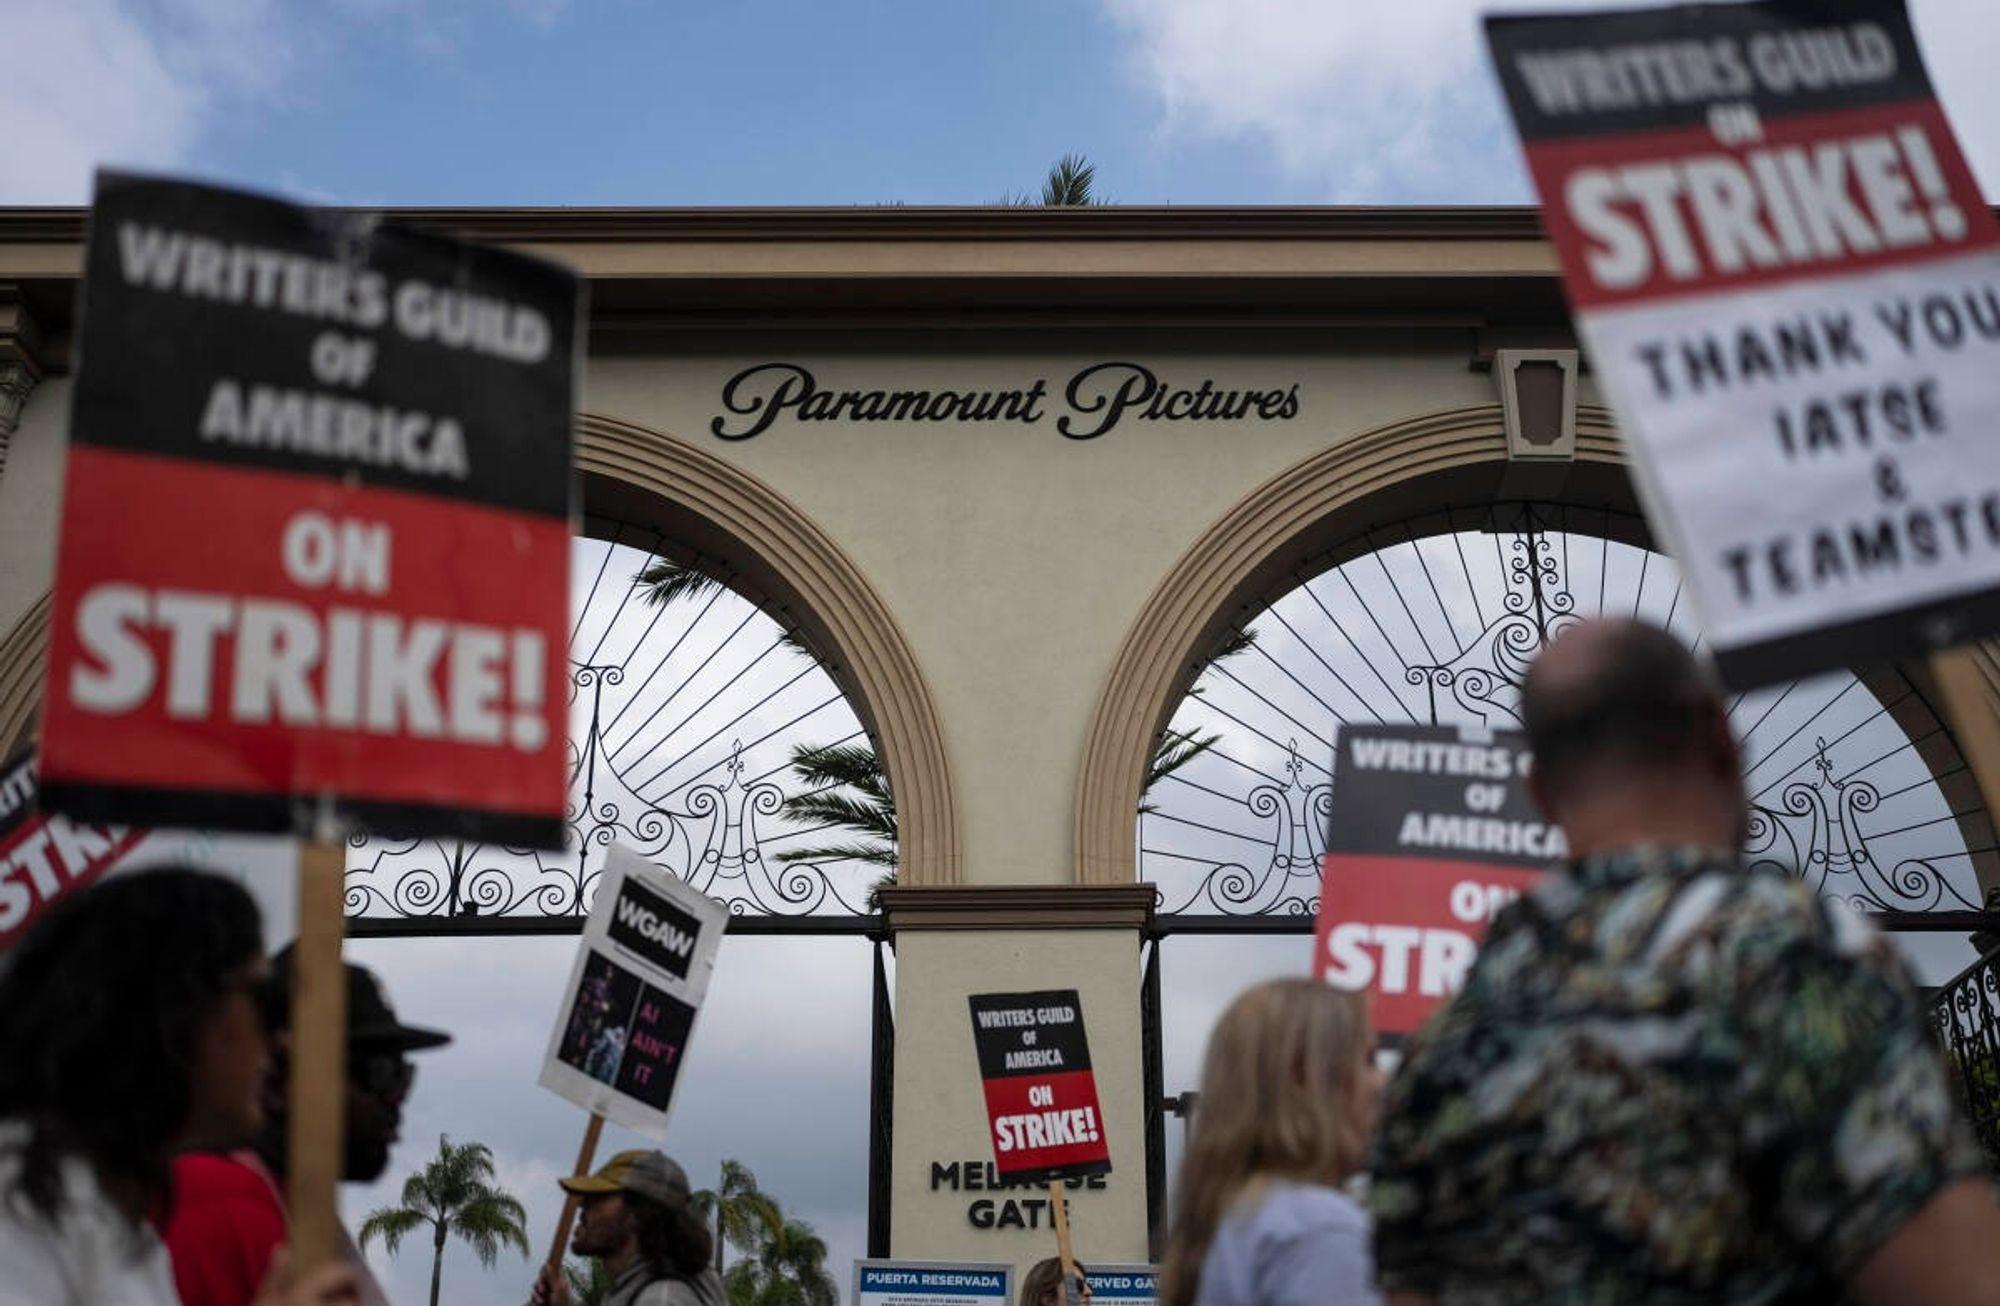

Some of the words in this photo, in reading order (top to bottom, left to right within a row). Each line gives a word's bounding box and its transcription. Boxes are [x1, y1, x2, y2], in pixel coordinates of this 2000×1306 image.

[1517, 37, 1753, 116] WRITERS
[1746, 21, 1896, 92] GUILD
[1707, 102, 1763, 148] ON
[1563, 125, 1967, 291] STRIKE!
[117, 222, 388, 326] WRITERS
[396, 280, 551, 365] GUILD
[311, 332, 378, 387] OF
[1637, 312, 1864, 398] THANK
[1875, 285, 2000, 354] YOU
[711, 362, 1046, 442] Paramount
[1057, 362, 1299, 441] Pictures
[1774, 377, 1945, 462] IATSE
[201, 380, 469, 480] AMERICA
[282, 510, 392, 595] ON
[68, 583, 549, 752] STRIKE!
[1350, 737, 1512, 778] WRITERS
[1463, 782, 1507, 811] OF
[1399, 812, 1570, 858] AMERICA
[618, 897, 693, 957] WGAW
[1325, 922, 1478, 997] STR
[641, 1003, 659, 1022] AI
[977, 1008, 1036, 1028] WRITERS
[1037, 1006, 1075, 1025] GUILD
[1005, 1049, 1064, 1069] AMERICA
[1022, 1031, 1037, 1045] OF
[635, 1064, 652, 1083] IT
[1029, 1085, 1053, 1106] ON
[995, 1107, 1098, 1151] STRIKE!
[866, 1272, 918, 1285] PUERTA
[922, 1274, 1000, 1288] RESERVADA
[1085, 1277, 1131, 1289] ERVED
[1134, 1277, 1157, 1289] GA
